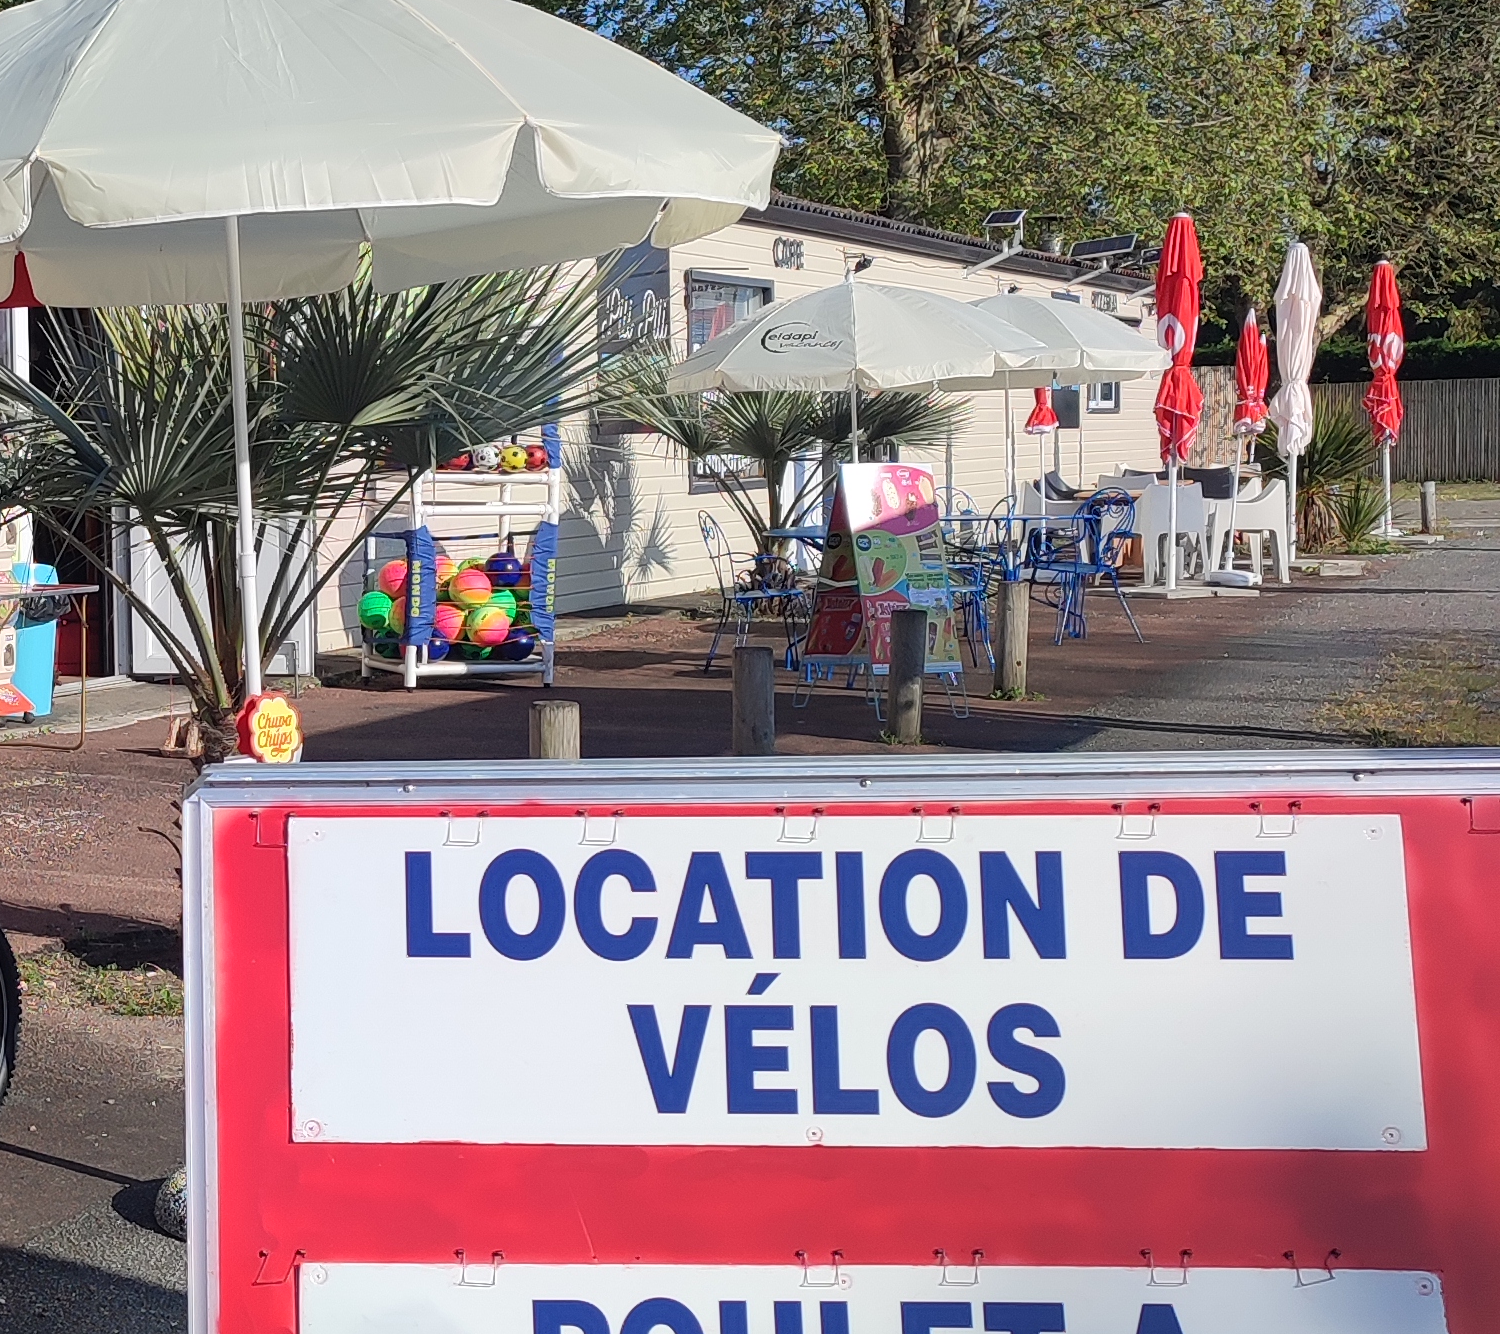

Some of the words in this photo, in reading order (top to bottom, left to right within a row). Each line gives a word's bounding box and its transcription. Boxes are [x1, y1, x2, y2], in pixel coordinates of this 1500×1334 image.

[257, 712, 293, 732] Chupa
[407, 850, 1065, 960] LOCATION
[1120, 853, 1293, 959] DE
[627, 973, 1066, 1118] VÉLOS
